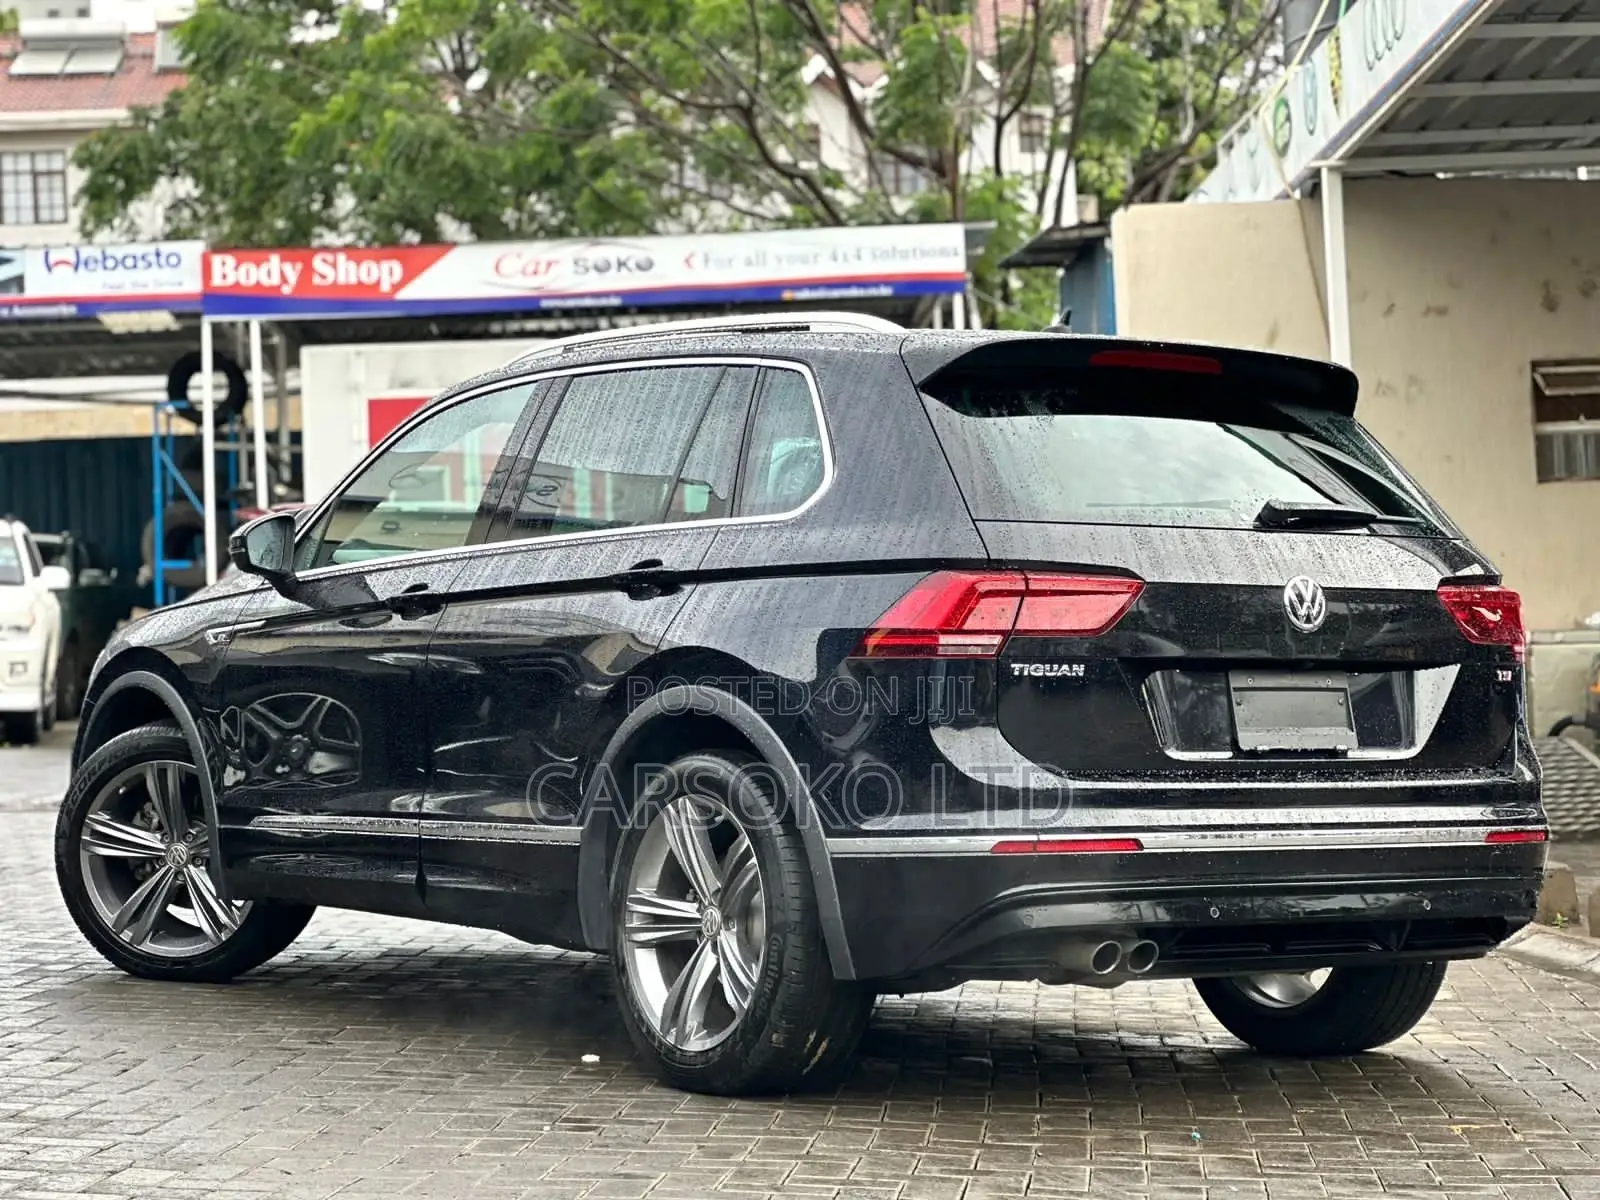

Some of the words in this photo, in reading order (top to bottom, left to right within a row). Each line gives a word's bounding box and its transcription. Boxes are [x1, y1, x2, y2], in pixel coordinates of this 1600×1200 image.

[44, 247, 182, 274] Webasto
[211, 254, 303, 295] Body
[312, 252, 403, 293] Shop
[494, 251, 560, 278] Car
[702, 253, 735, 270] For
[744, 248, 769, 267] all
[774, 249, 820, 273] your
[1010, 663, 1085, 677] TIGUAN
